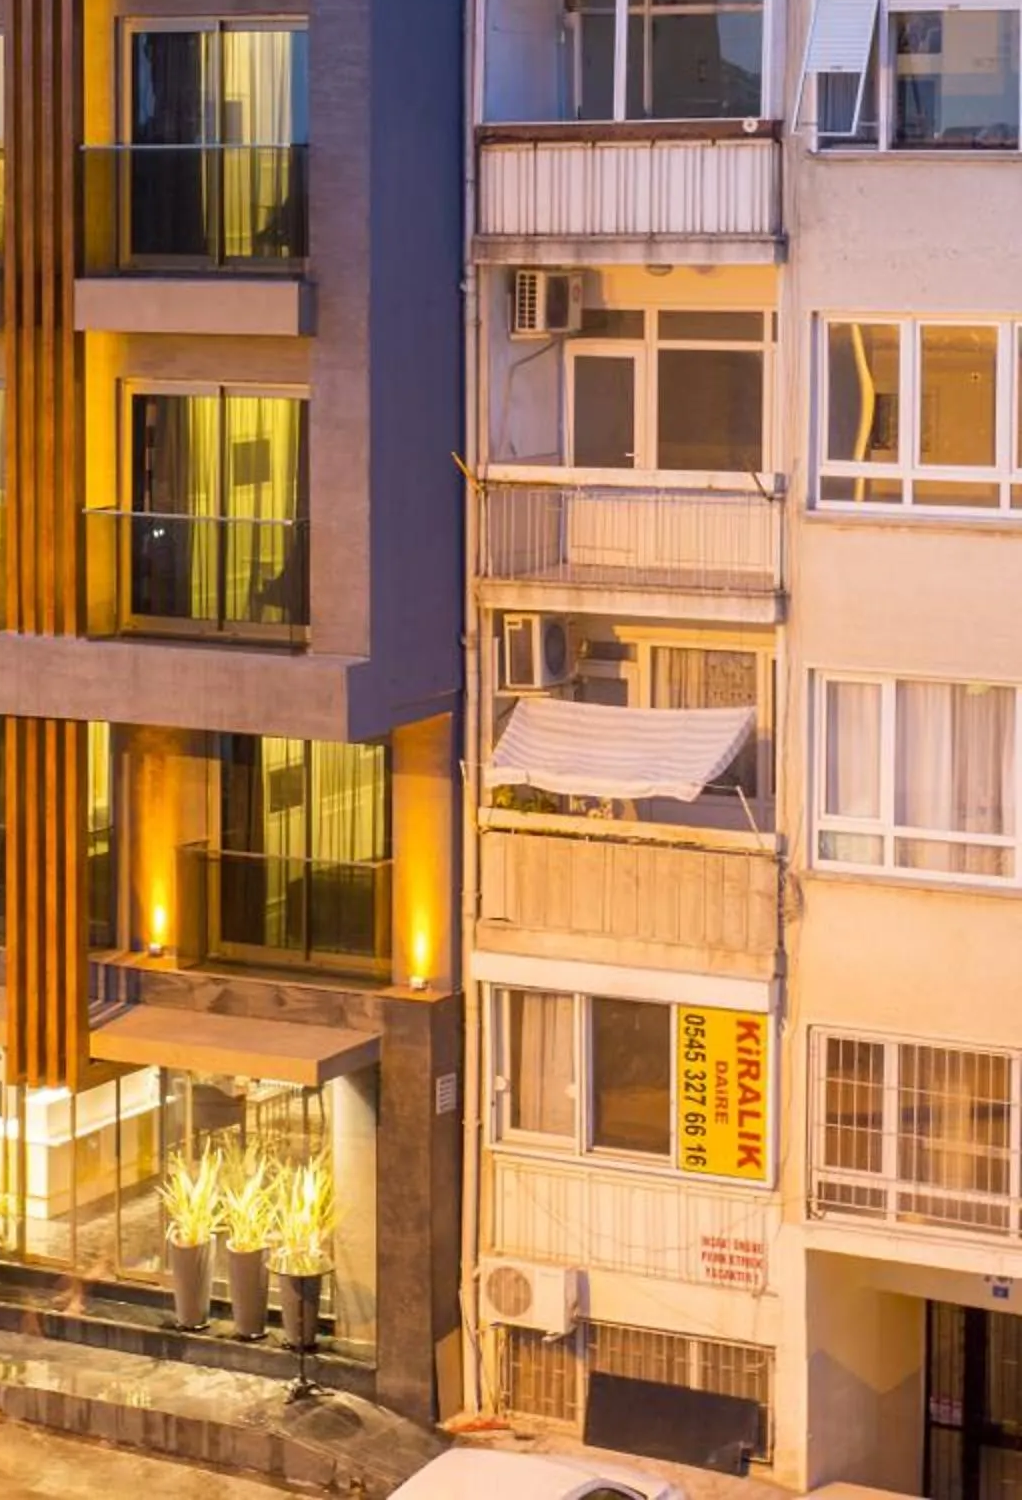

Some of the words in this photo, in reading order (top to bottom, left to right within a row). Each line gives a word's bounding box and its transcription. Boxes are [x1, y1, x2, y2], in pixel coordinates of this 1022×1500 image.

[684, 1013, 706, 1062] 0545
[684, 1069, 707, 1106] 327
[684, 1111, 707, 1136] 66
[685, 1145, 707, 1167] 16
